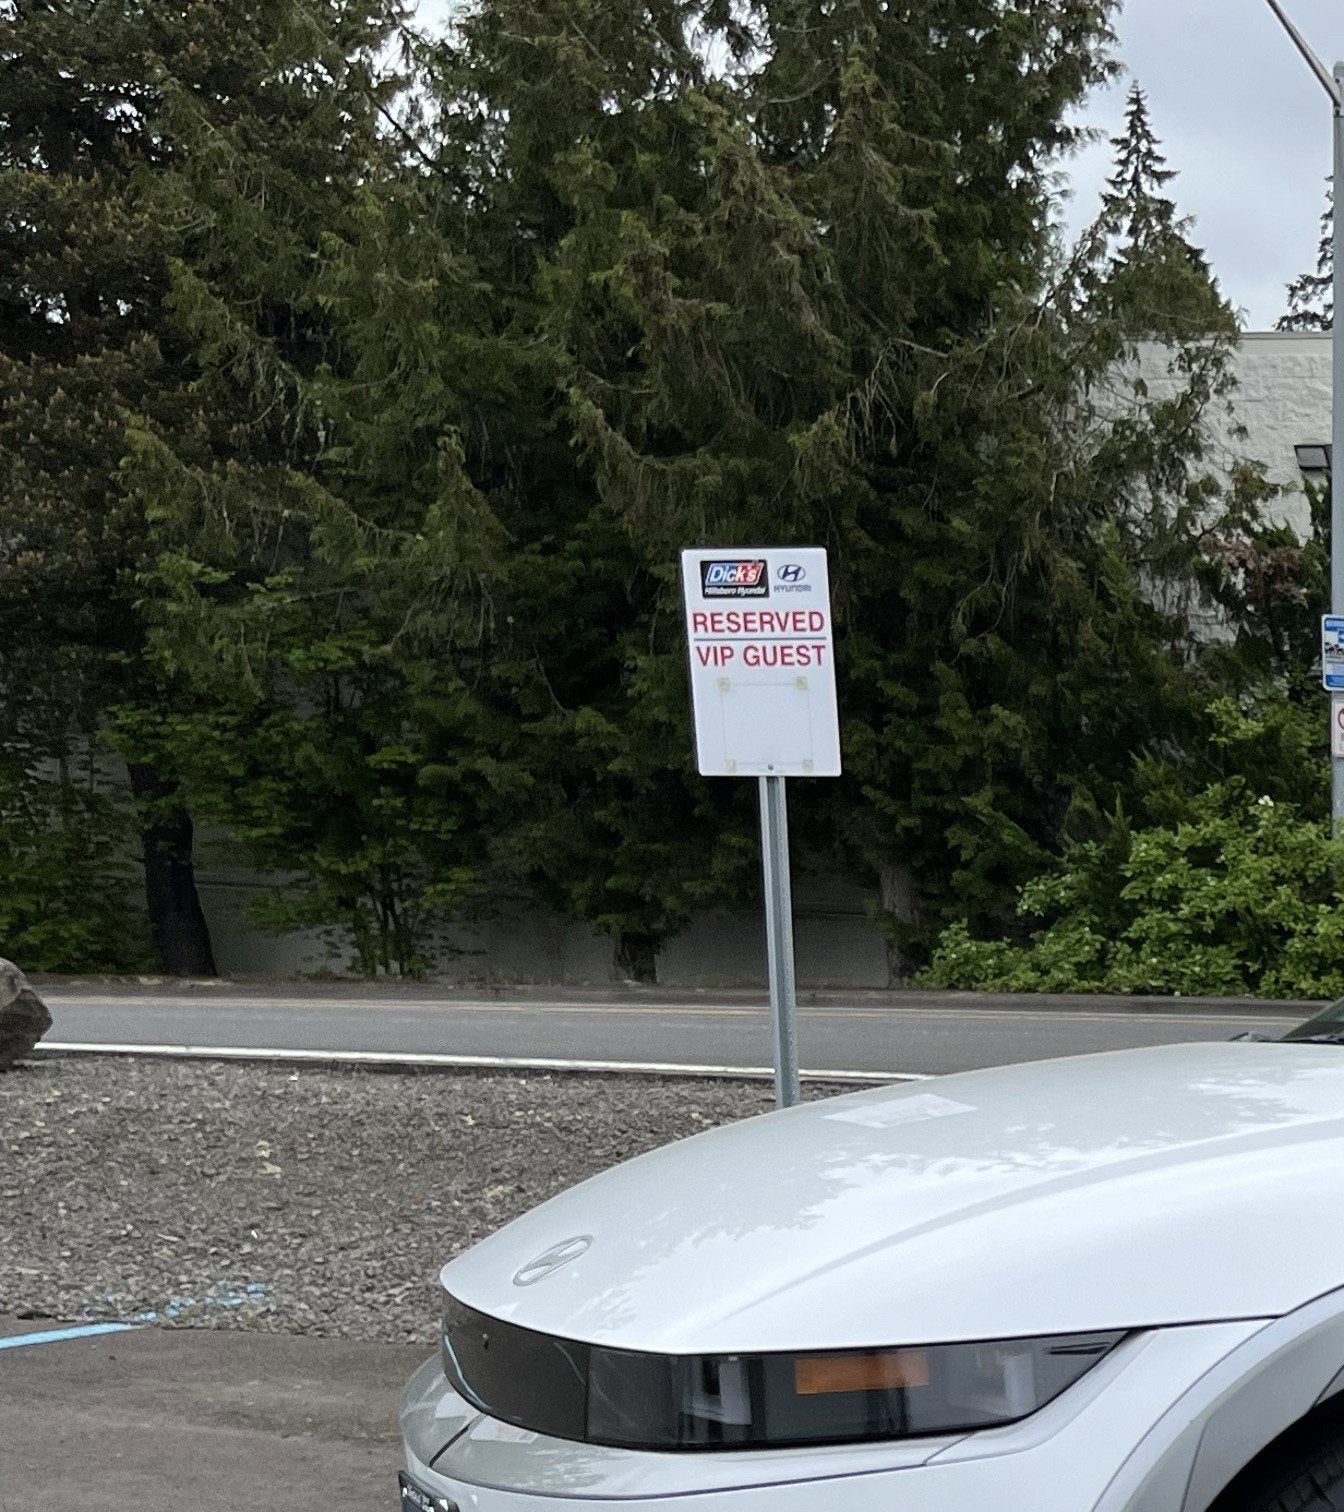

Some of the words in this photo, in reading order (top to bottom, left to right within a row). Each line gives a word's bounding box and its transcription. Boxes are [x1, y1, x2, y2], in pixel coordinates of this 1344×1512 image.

[692, 610, 825, 634] RESERVED
[696, 645, 735, 668] VIP
[742, 644, 826, 668] GUEST
